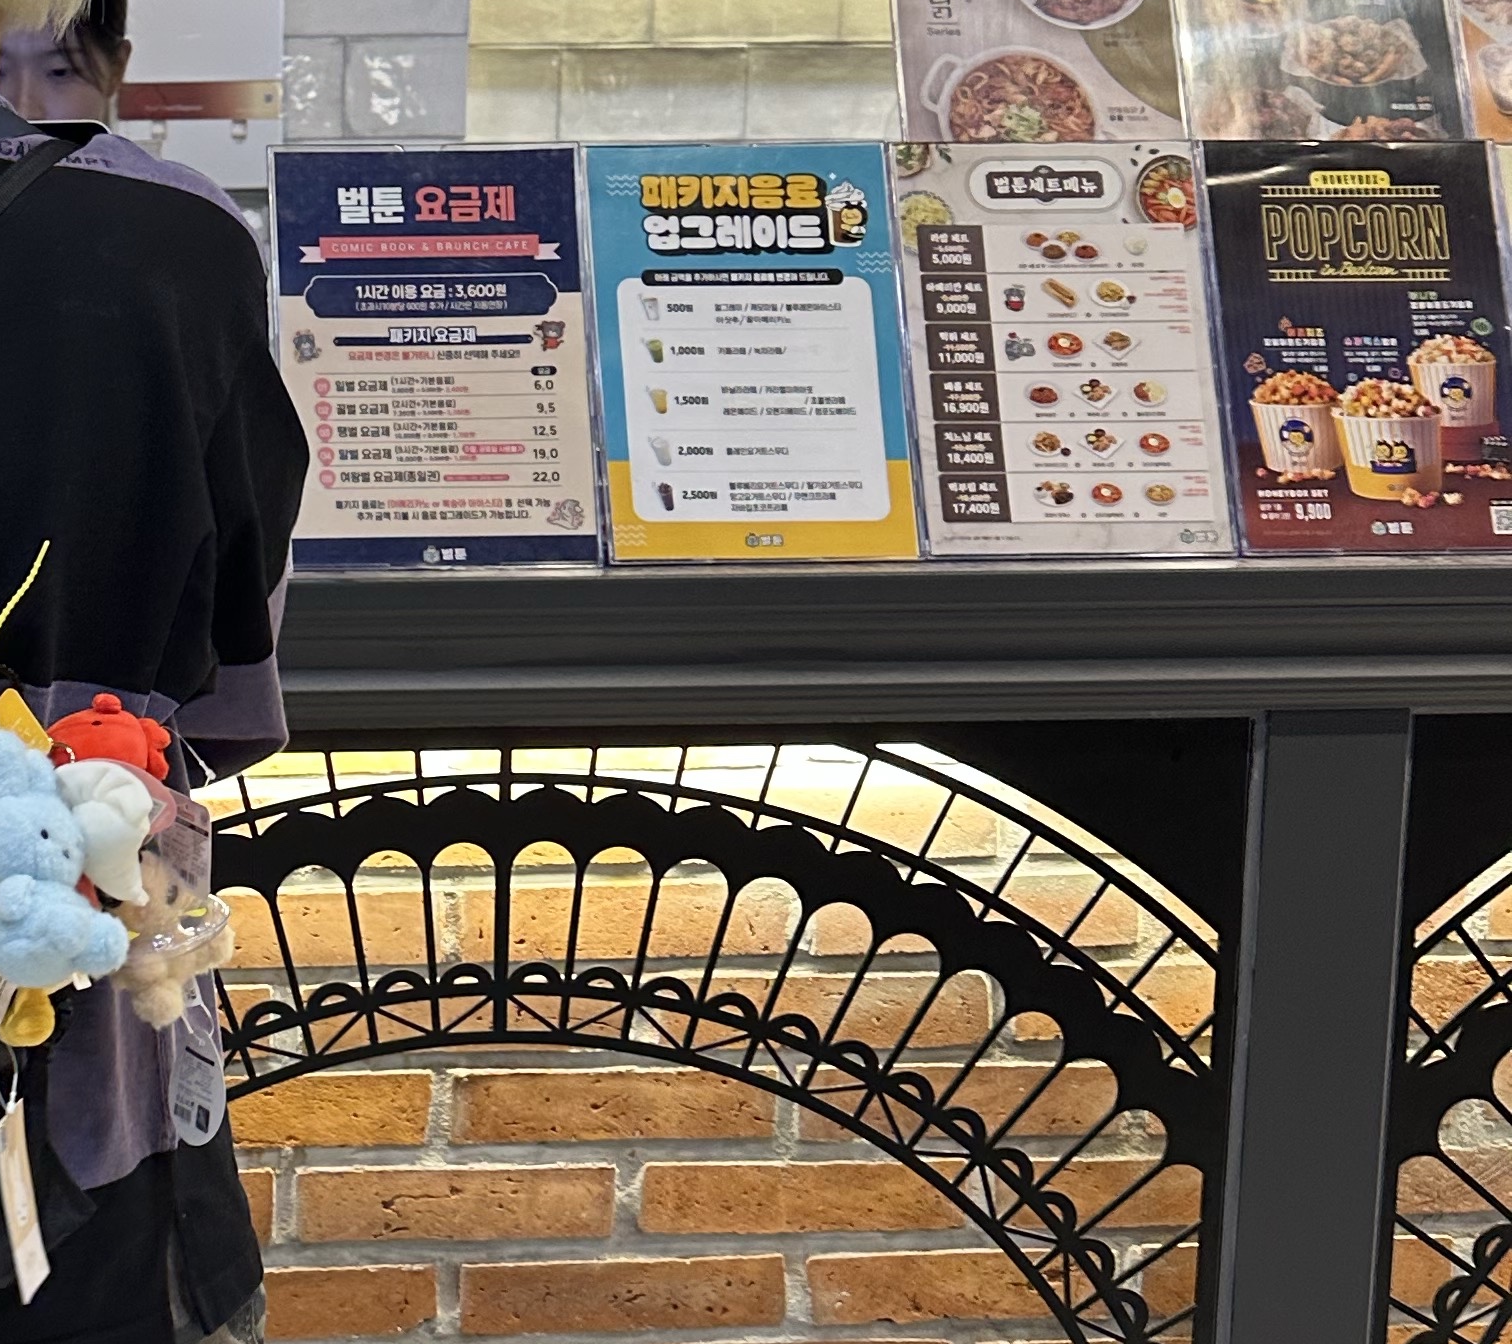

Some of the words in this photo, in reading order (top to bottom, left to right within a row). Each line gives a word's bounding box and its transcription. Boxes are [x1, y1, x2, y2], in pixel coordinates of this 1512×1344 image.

[927, 27, 961, 36] Series
[1322, 175, 1379, 184] HONEYBOX
[641, 175, 822, 209] 패키지음료
[338, 187, 404, 224] 벌툰
[415, 185, 515, 223] 요금제
[644, 215, 825, 249] 업그레이드
[1260, 204, 1450, 261] POPCORN
[332, 243, 372, 252] COMIC
[381, 242, 414, 252] BOOK
[421, 242, 429, 251] &
[438, 241, 488, 250] BRUNCH
[497, 240, 528, 250] CAFE
[932, 254, 972, 265] 5,000원
[356, 285, 389, 299] 1시간
[392, 284, 417, 298] 이용
[420, 284, 446, 298] 요금
[455, 284, 507, 298] 3,600원
[936, 303, 976, 314] 9,000원
[389, 328, 431, 344] 패키지
[434, 327, 476, 343] 요금제
[939, 353, 984, 364] 11,000원
[359, 380, 388, 391] 요금제
[359, 403, 389, 415] 요금제
[943, 403, 989, 414] 16,900원
[361, 426, 390, 437] 요금제
[362, 449, 391, 460] 요금제
[947, 453, 994, 464] 18,400원
[1311, 489, 1328, 497] SET
[953, 503, 999, 515] 17,400원
[1295, 504, 1332, 522] 9,900
